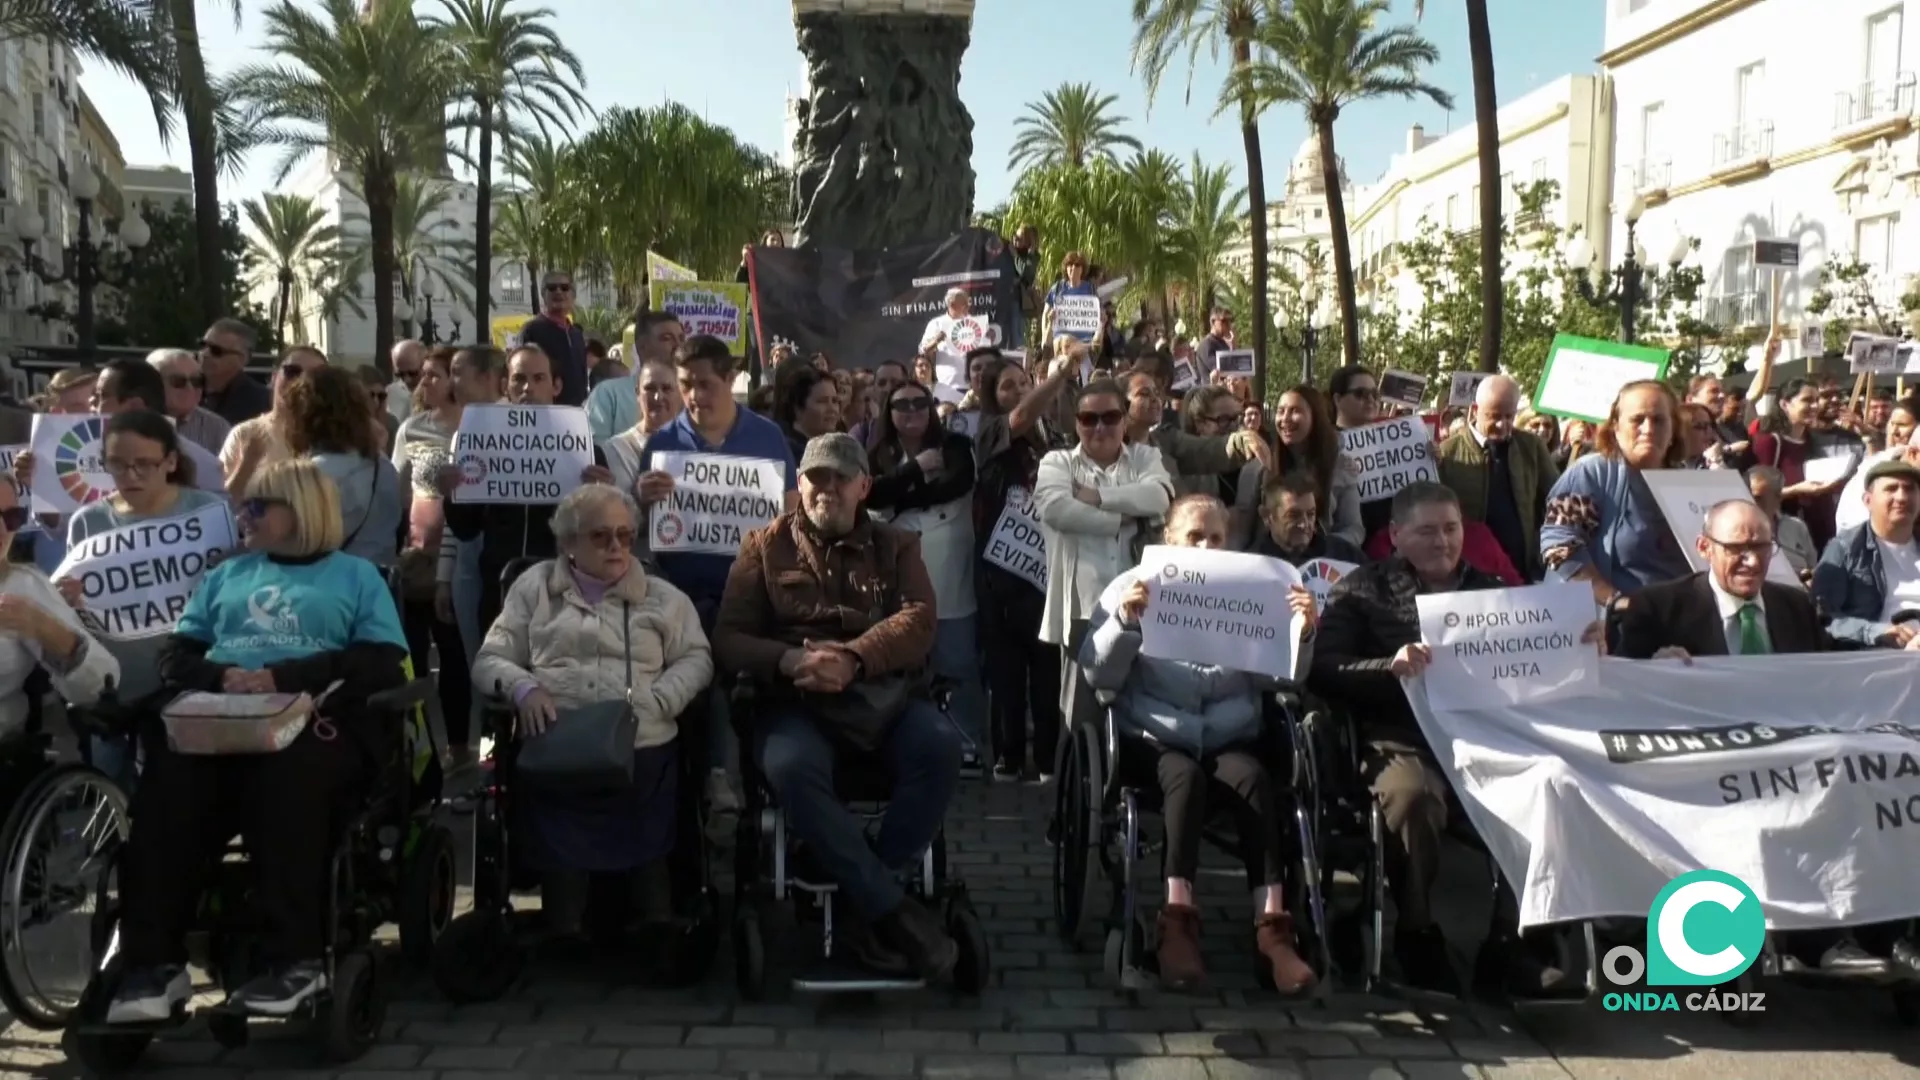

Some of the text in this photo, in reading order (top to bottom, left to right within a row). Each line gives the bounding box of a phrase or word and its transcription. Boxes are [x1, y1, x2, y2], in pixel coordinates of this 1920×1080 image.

[691, 292, 716, 305] UNA
[1064, 299, 1094, 307] JUNTOS
[881, 305, 901, 317] SIN
[1058, 309, 1098, 318] PODEMOS
[697, 320, 737, 338] JUSTA
[1058, 319, 1098, 328] EVITARLO
[507, 410, 537, 428] SIN
[458, 430, 588, 452] FINANCIACIÓN
[1346, 421, 1412, 452] JUNTOS
[488, 457, 557, 475] NO HAY
[683, 461, 761, 489] POR UNA
[487, 480, 561, 498] FUTURO
[73, 516, 203, 562] JUNTOS
[81, 547, 223, 599] ODEMOS
[1183, 570, 1206, 586] SIN
[1159, 589, 1265, 616] FINANCIACIÓN
[1156, 611, 1276, 641] NO HAY FUTURO
[1466, 608, 1553, 629] #POR UNA
[1453, 632, 1573, 658] FINANCIACIÓN
[1491, 662, 1541, 680] JUSTA
[1718, 766, 1800, 804] SIN
